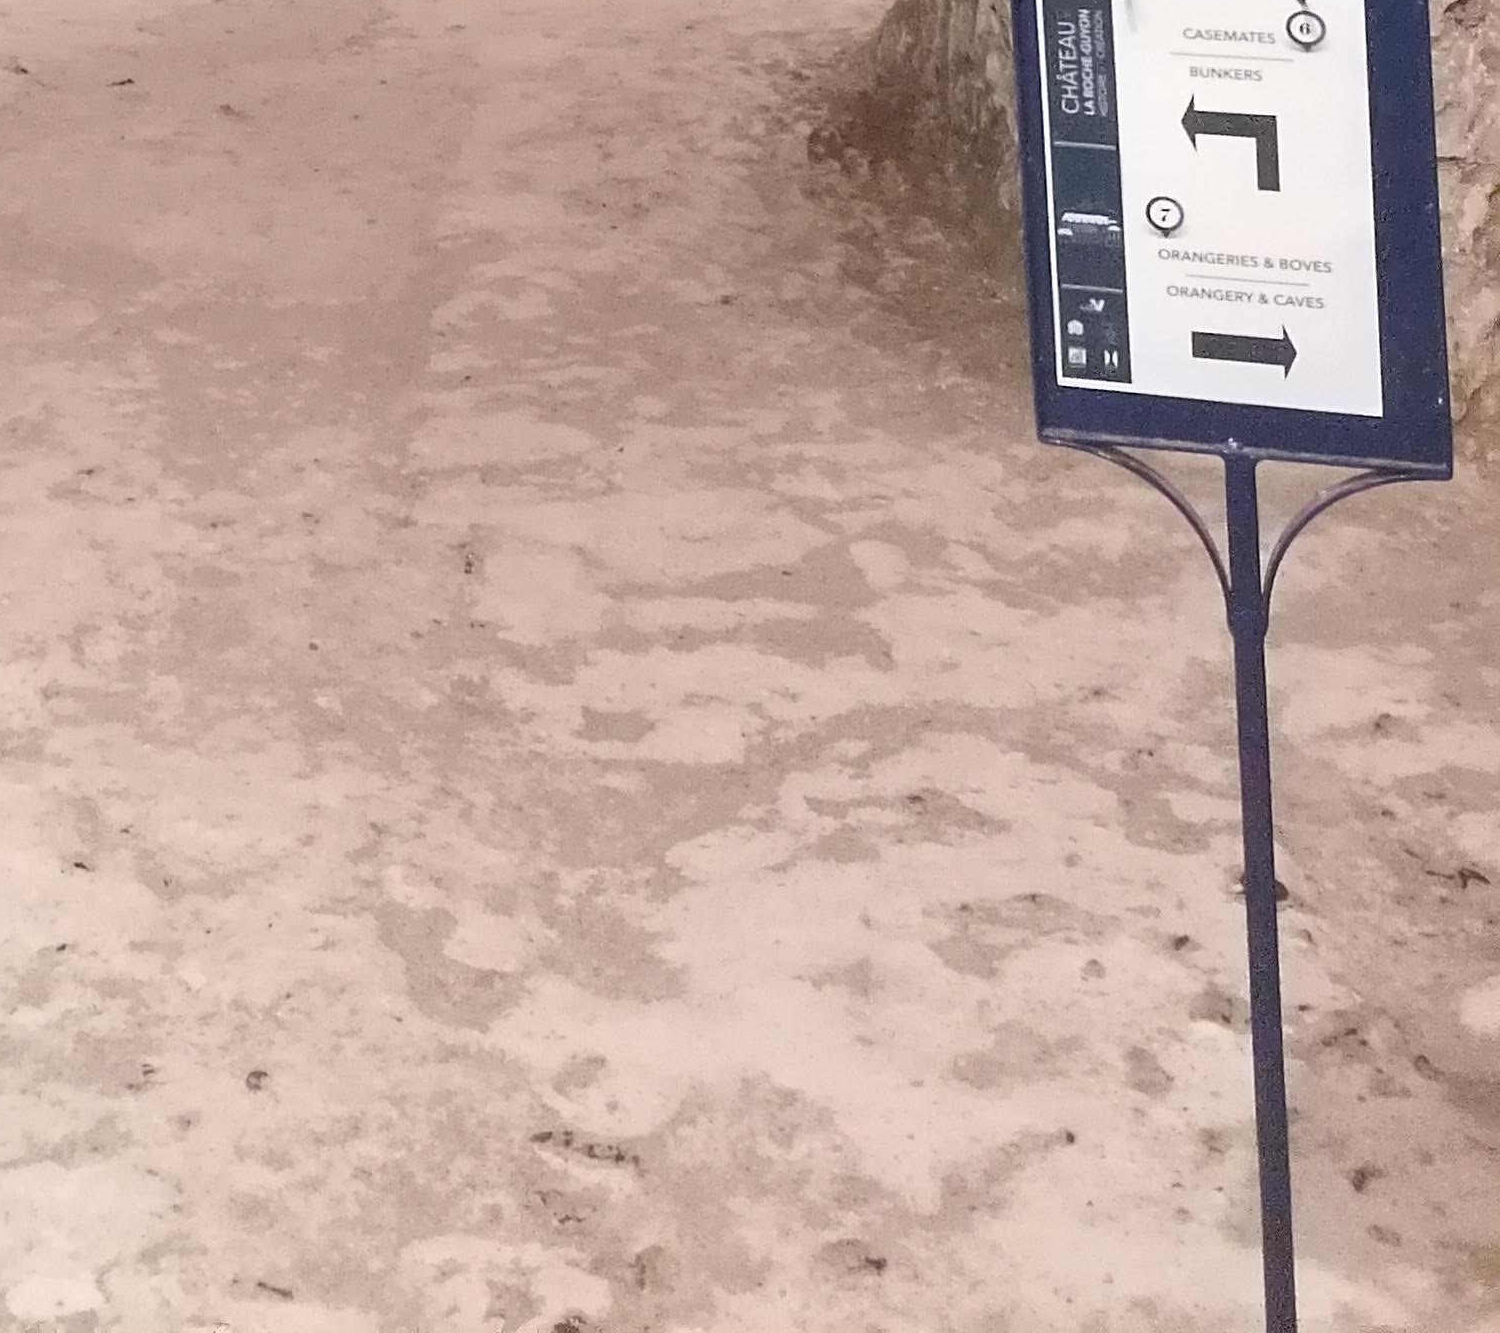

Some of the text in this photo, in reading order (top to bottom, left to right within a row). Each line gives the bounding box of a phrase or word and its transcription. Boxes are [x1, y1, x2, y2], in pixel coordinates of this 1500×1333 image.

[1182, 27, 1276, 44] CASEMATES
[1299, 22, 1311, 36] 6
[1056, 21, 1080, 114] CHÂTEAU
[1189, 66, 1263, 82] BUNKERS
[1083, 100, 1095, 116] LA
[1160, 208, 1171, 222] 7
[1158, 248, 1333, 274] ORANGERIES & BOVES
[1166, 285, 1325, 310] ORANGERY & CAVES
